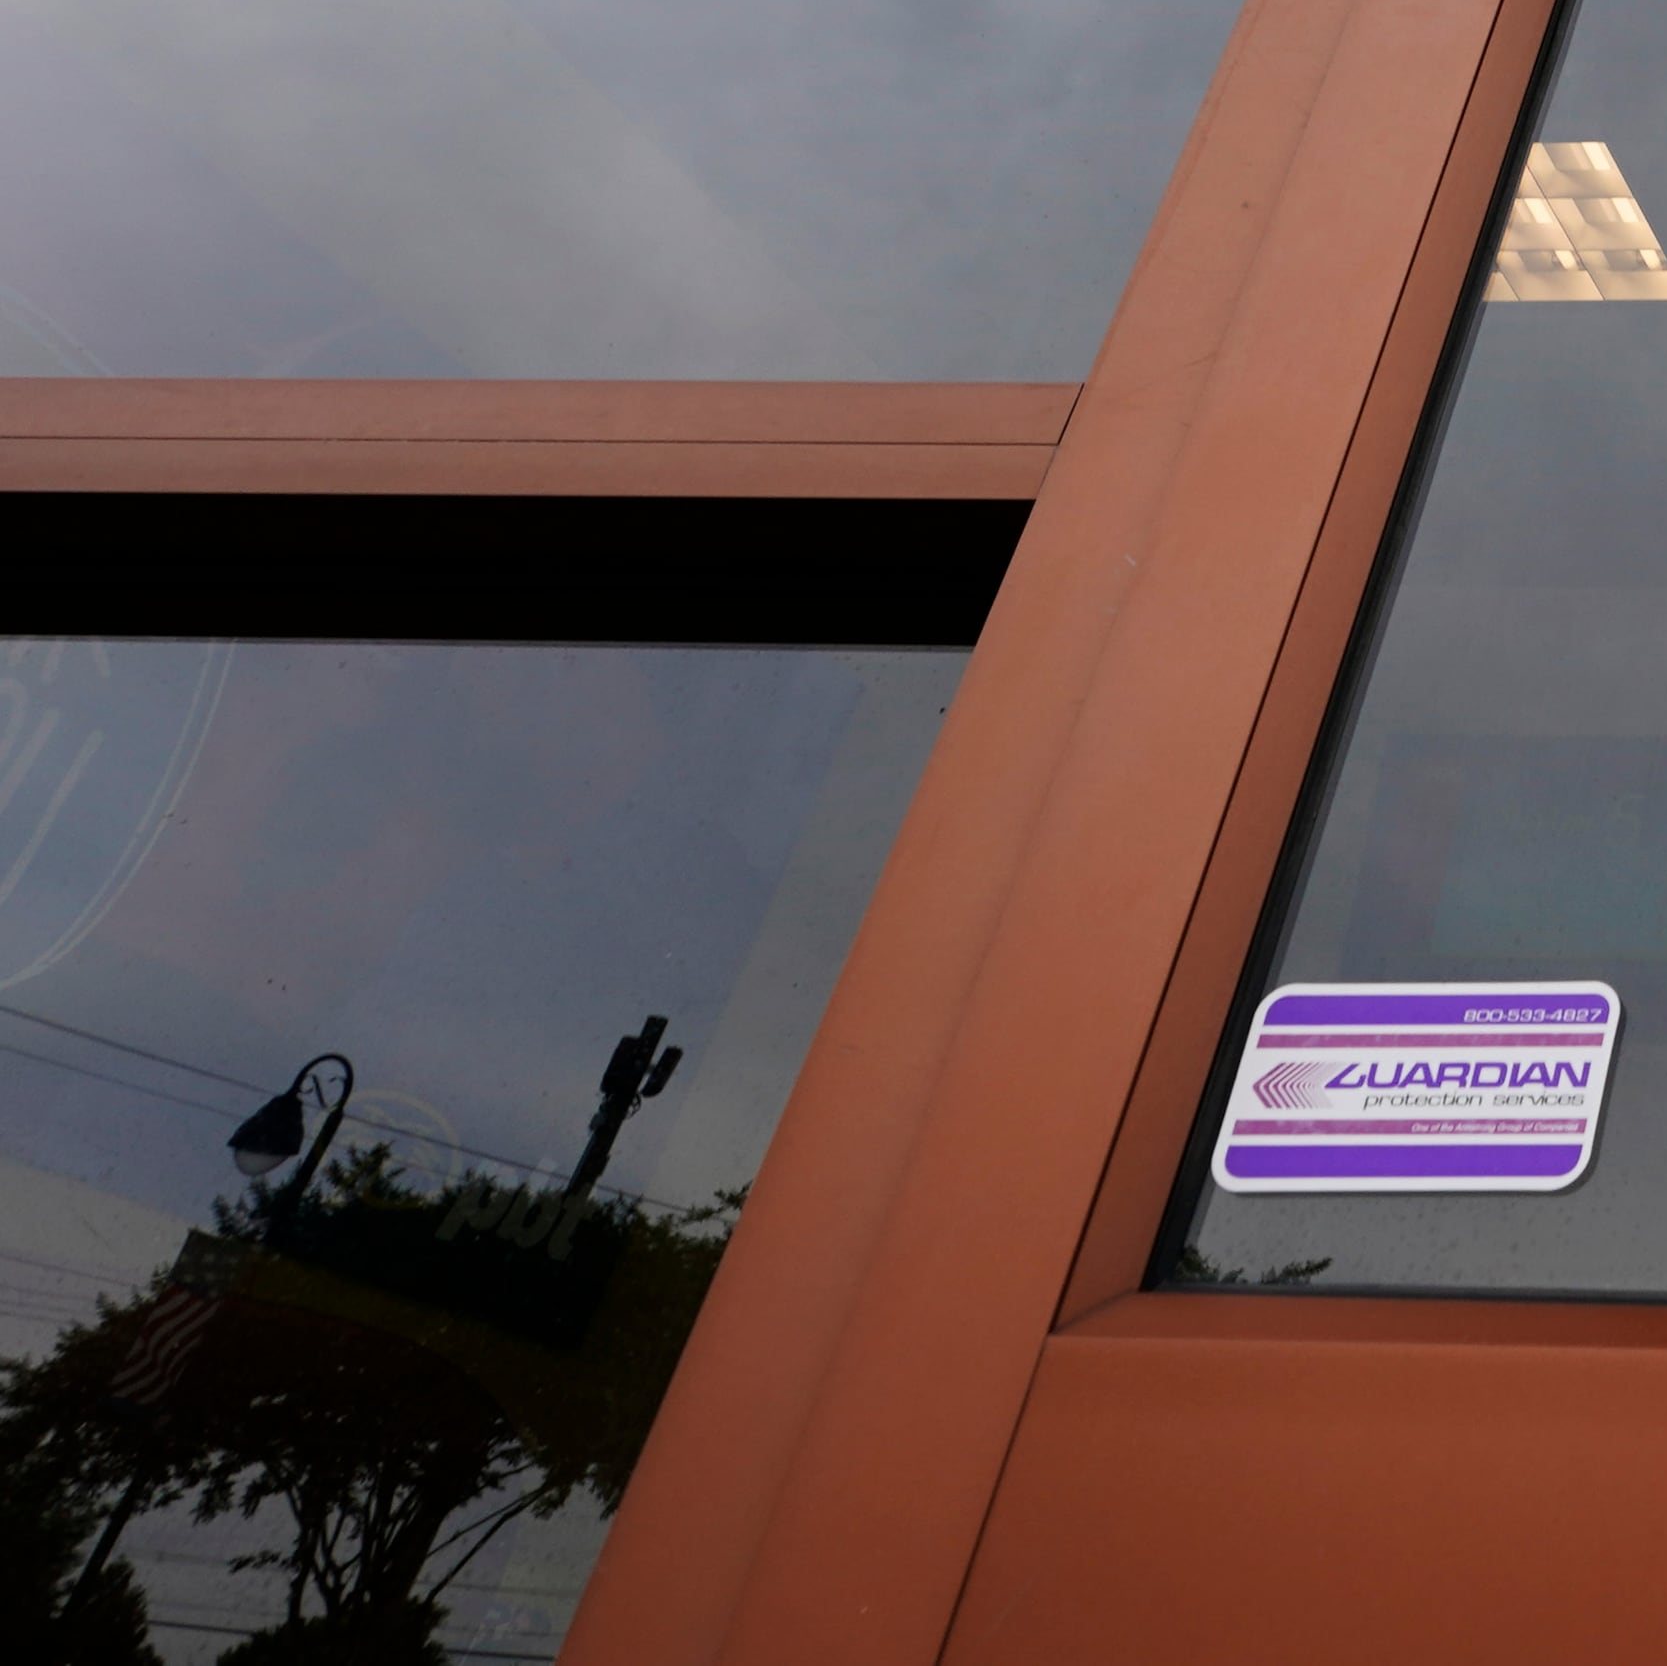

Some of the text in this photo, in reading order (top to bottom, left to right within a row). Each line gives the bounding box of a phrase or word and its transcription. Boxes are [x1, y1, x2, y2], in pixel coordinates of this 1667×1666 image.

[1324, 1061, 1592, 1089] GUARDIAN
[1363, 1089, 1585, 1111] protection services
